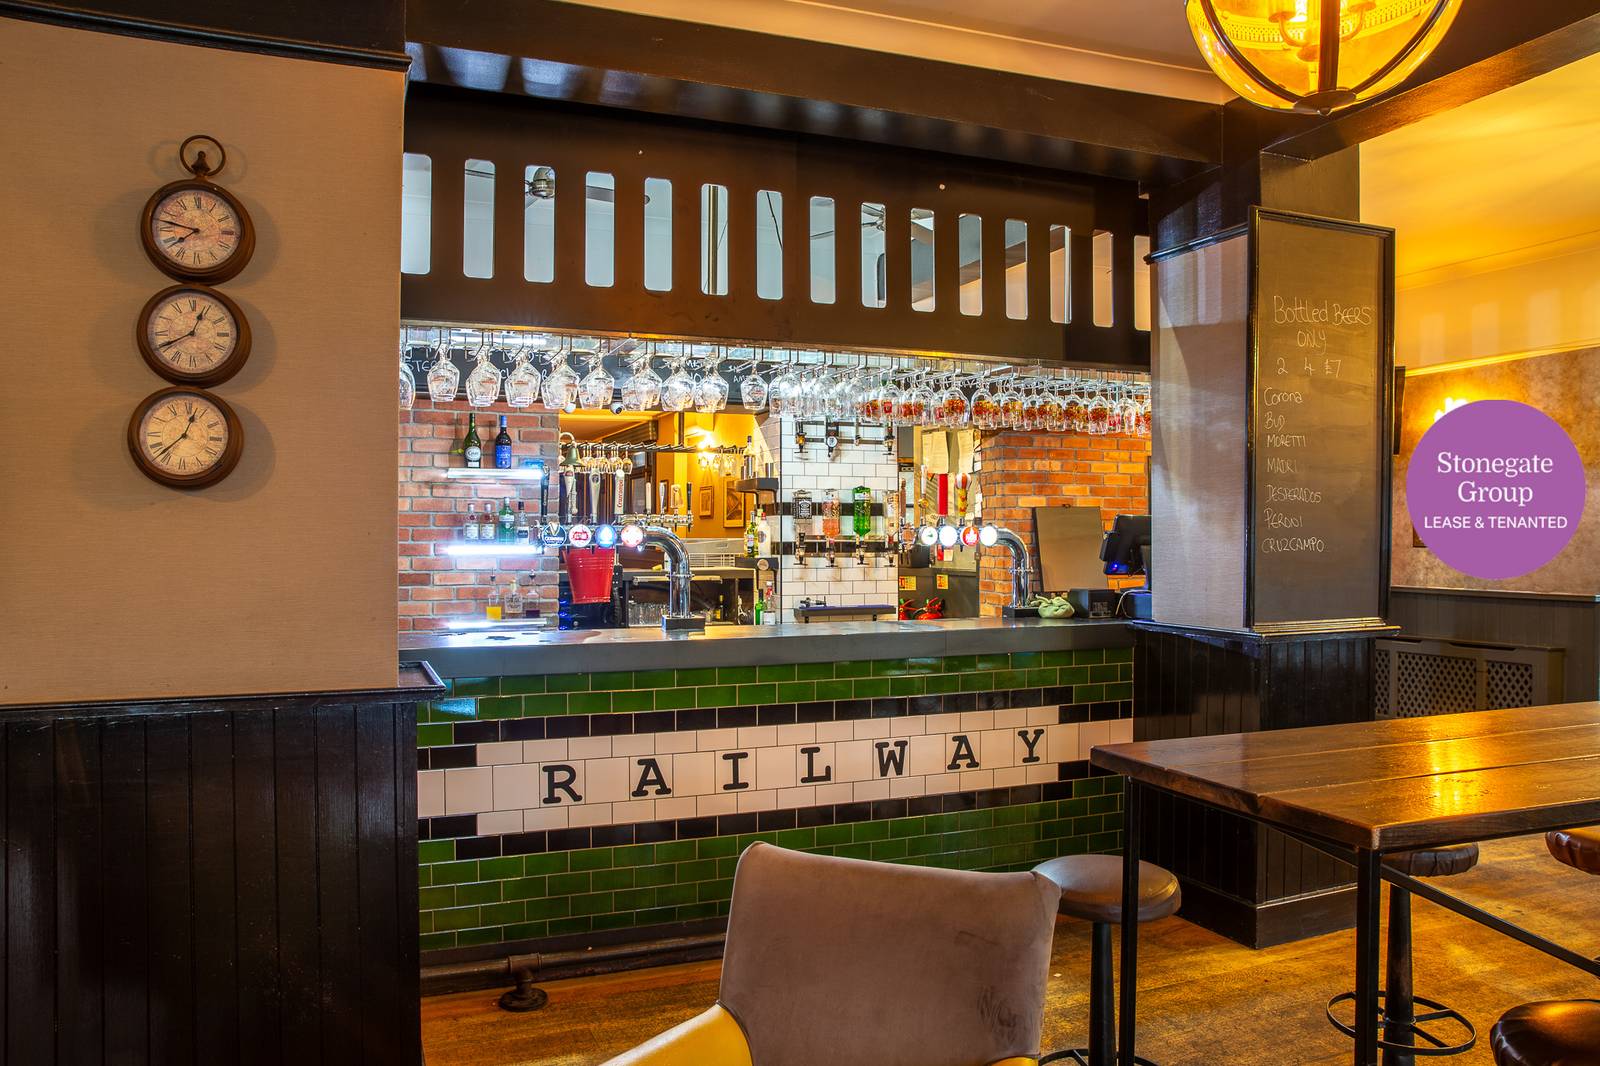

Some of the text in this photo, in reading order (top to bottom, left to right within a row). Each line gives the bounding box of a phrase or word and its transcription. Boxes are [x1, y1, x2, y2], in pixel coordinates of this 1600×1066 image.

[1273, 295, 1329, 324] Bottled
[1276, 357, 1288, 375] 2
[1304, 356, 1315, 376] 4
[1263, 386, 1303, 407] Corona
[1266, 434, 1307, 448] MORETTI
[1265, 484, 1322, 504] DESPERADOS
[542, 728, 1045, 804] RAILWAY
